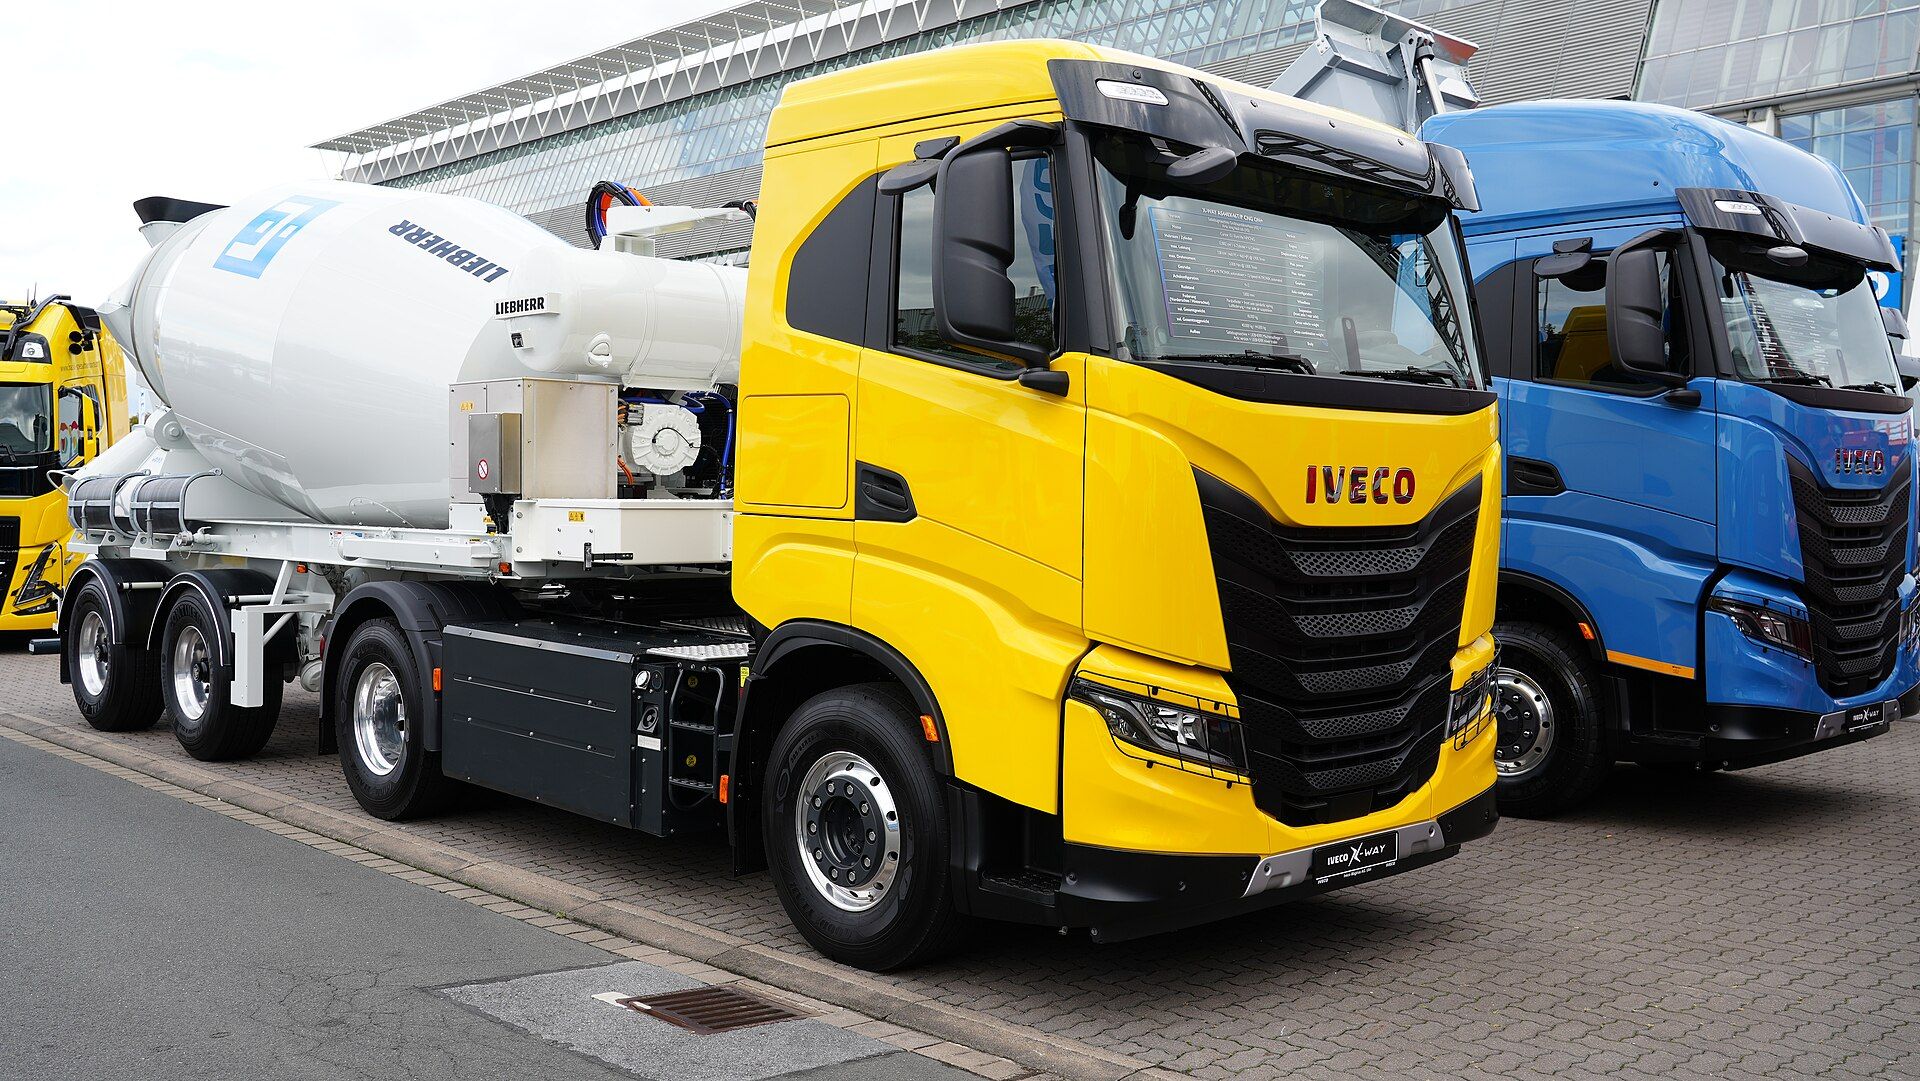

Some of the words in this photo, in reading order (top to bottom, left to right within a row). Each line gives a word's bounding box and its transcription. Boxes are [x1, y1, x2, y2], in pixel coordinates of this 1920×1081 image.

[388, 219, 509, 283] LIEBHERR
[495, 296, 545, 315] LIEBHERR
[1834, 448, 1884, 475] IVECO
[1305, 465, 1416, 505] IVECO
[1327, 853, 1349, 866] IVECO
[1348, 842, 1386, 867] X-WAY
